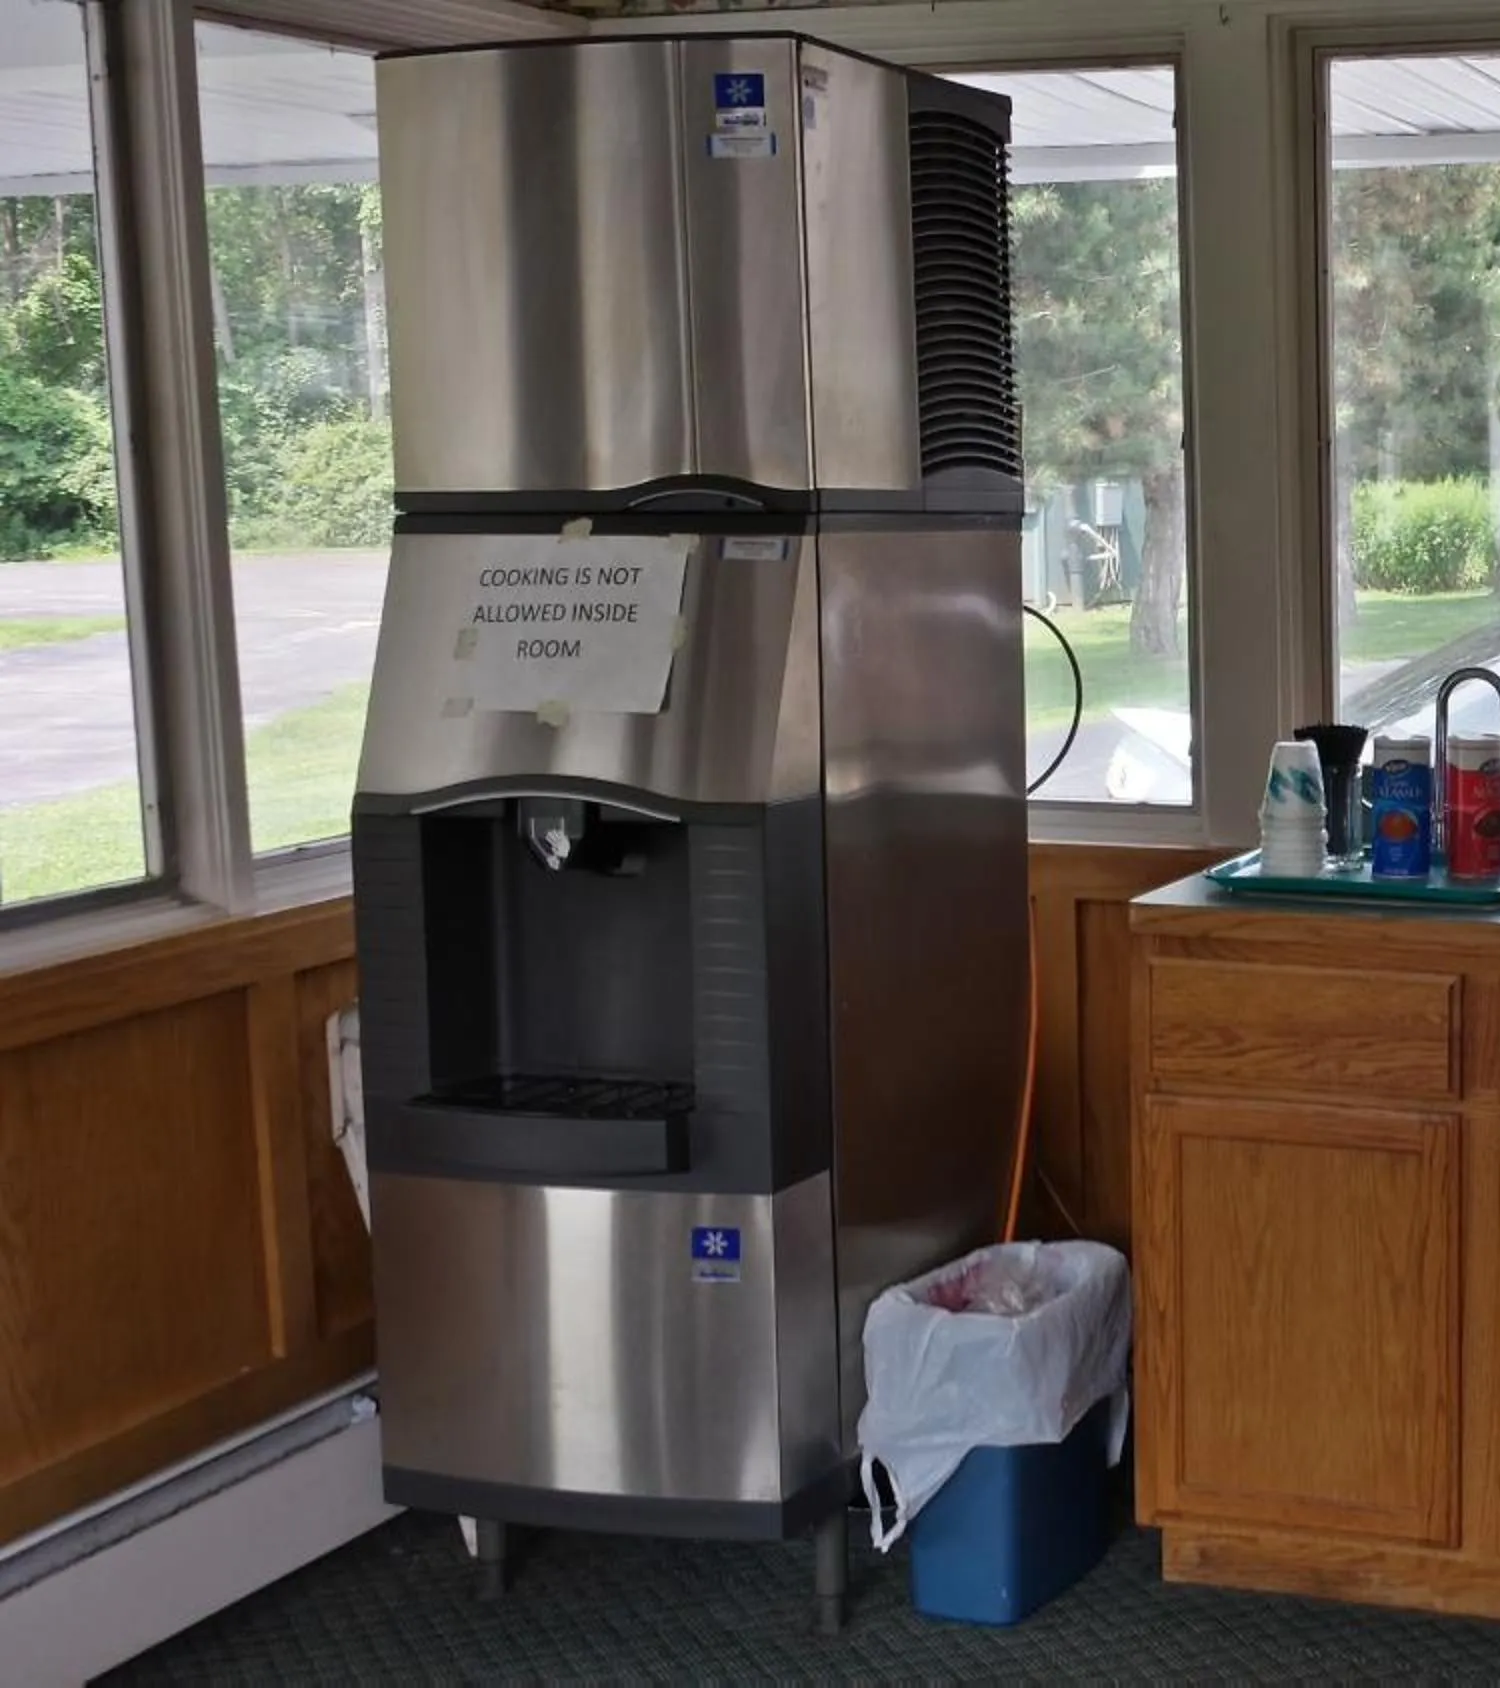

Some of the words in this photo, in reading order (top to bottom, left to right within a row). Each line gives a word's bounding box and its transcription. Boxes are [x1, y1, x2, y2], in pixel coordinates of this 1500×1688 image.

[479, 567, 569, 587] COOKING
[574, 567, 591, 586] IS
[597, 567, 643, 587] NOT
[473, 603, 566, 623] ALLOWED
[572, 603, 639, 623] INSIDE
[516, 639, 581, 659] ROOM
